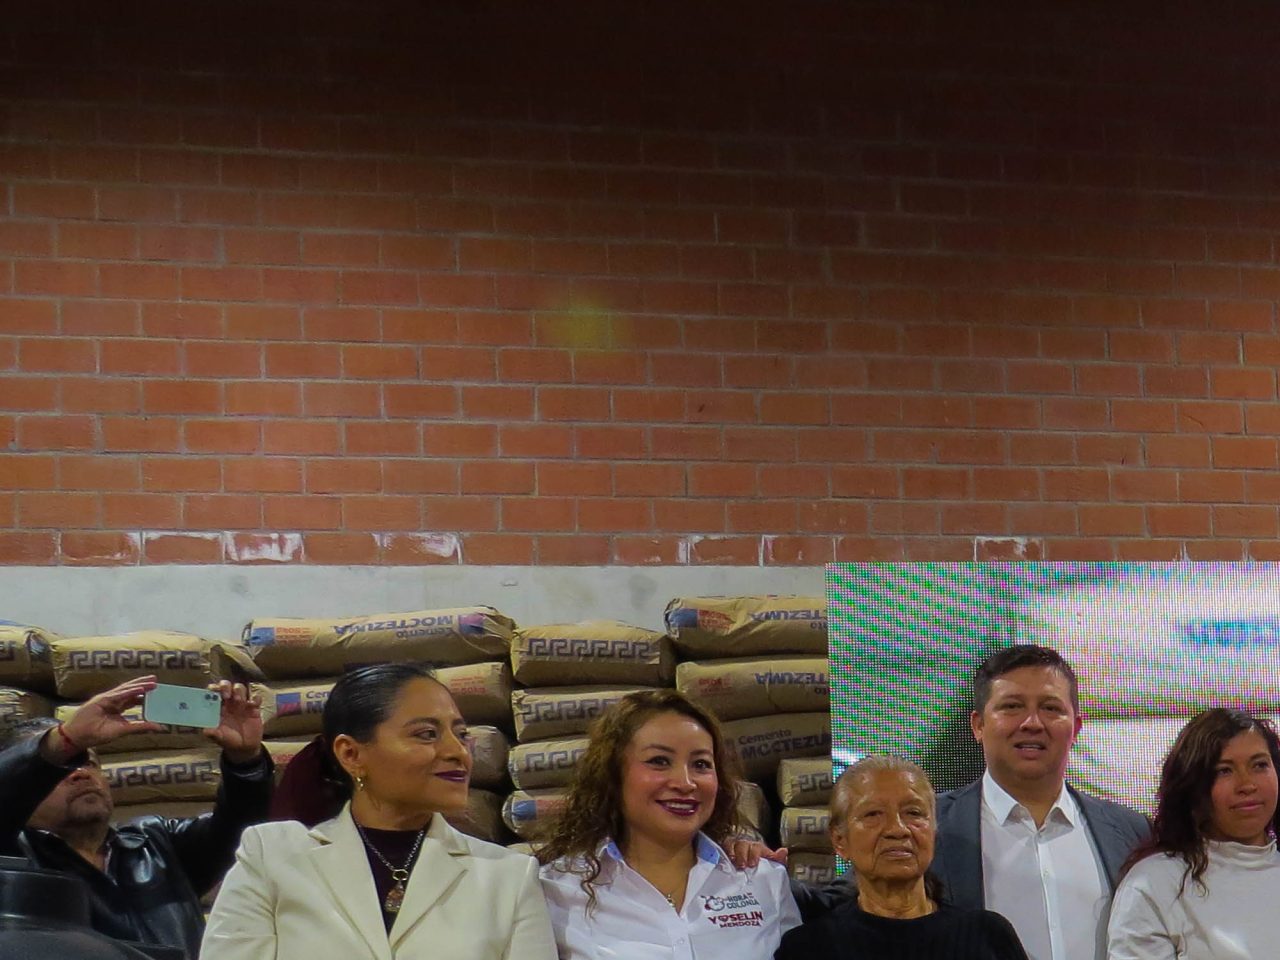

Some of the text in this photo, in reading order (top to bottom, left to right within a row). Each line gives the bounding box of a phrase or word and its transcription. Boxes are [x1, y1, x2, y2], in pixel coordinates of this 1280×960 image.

[750, 609, 827, 621] TEZUMA
[331, 615, 454, 636] MOCTEZUMA
[754, 672, 828, 685] TEZUMA
[738, 729, 792, 745] Cemento
[720, 920, 761, 928] MENDOZA
